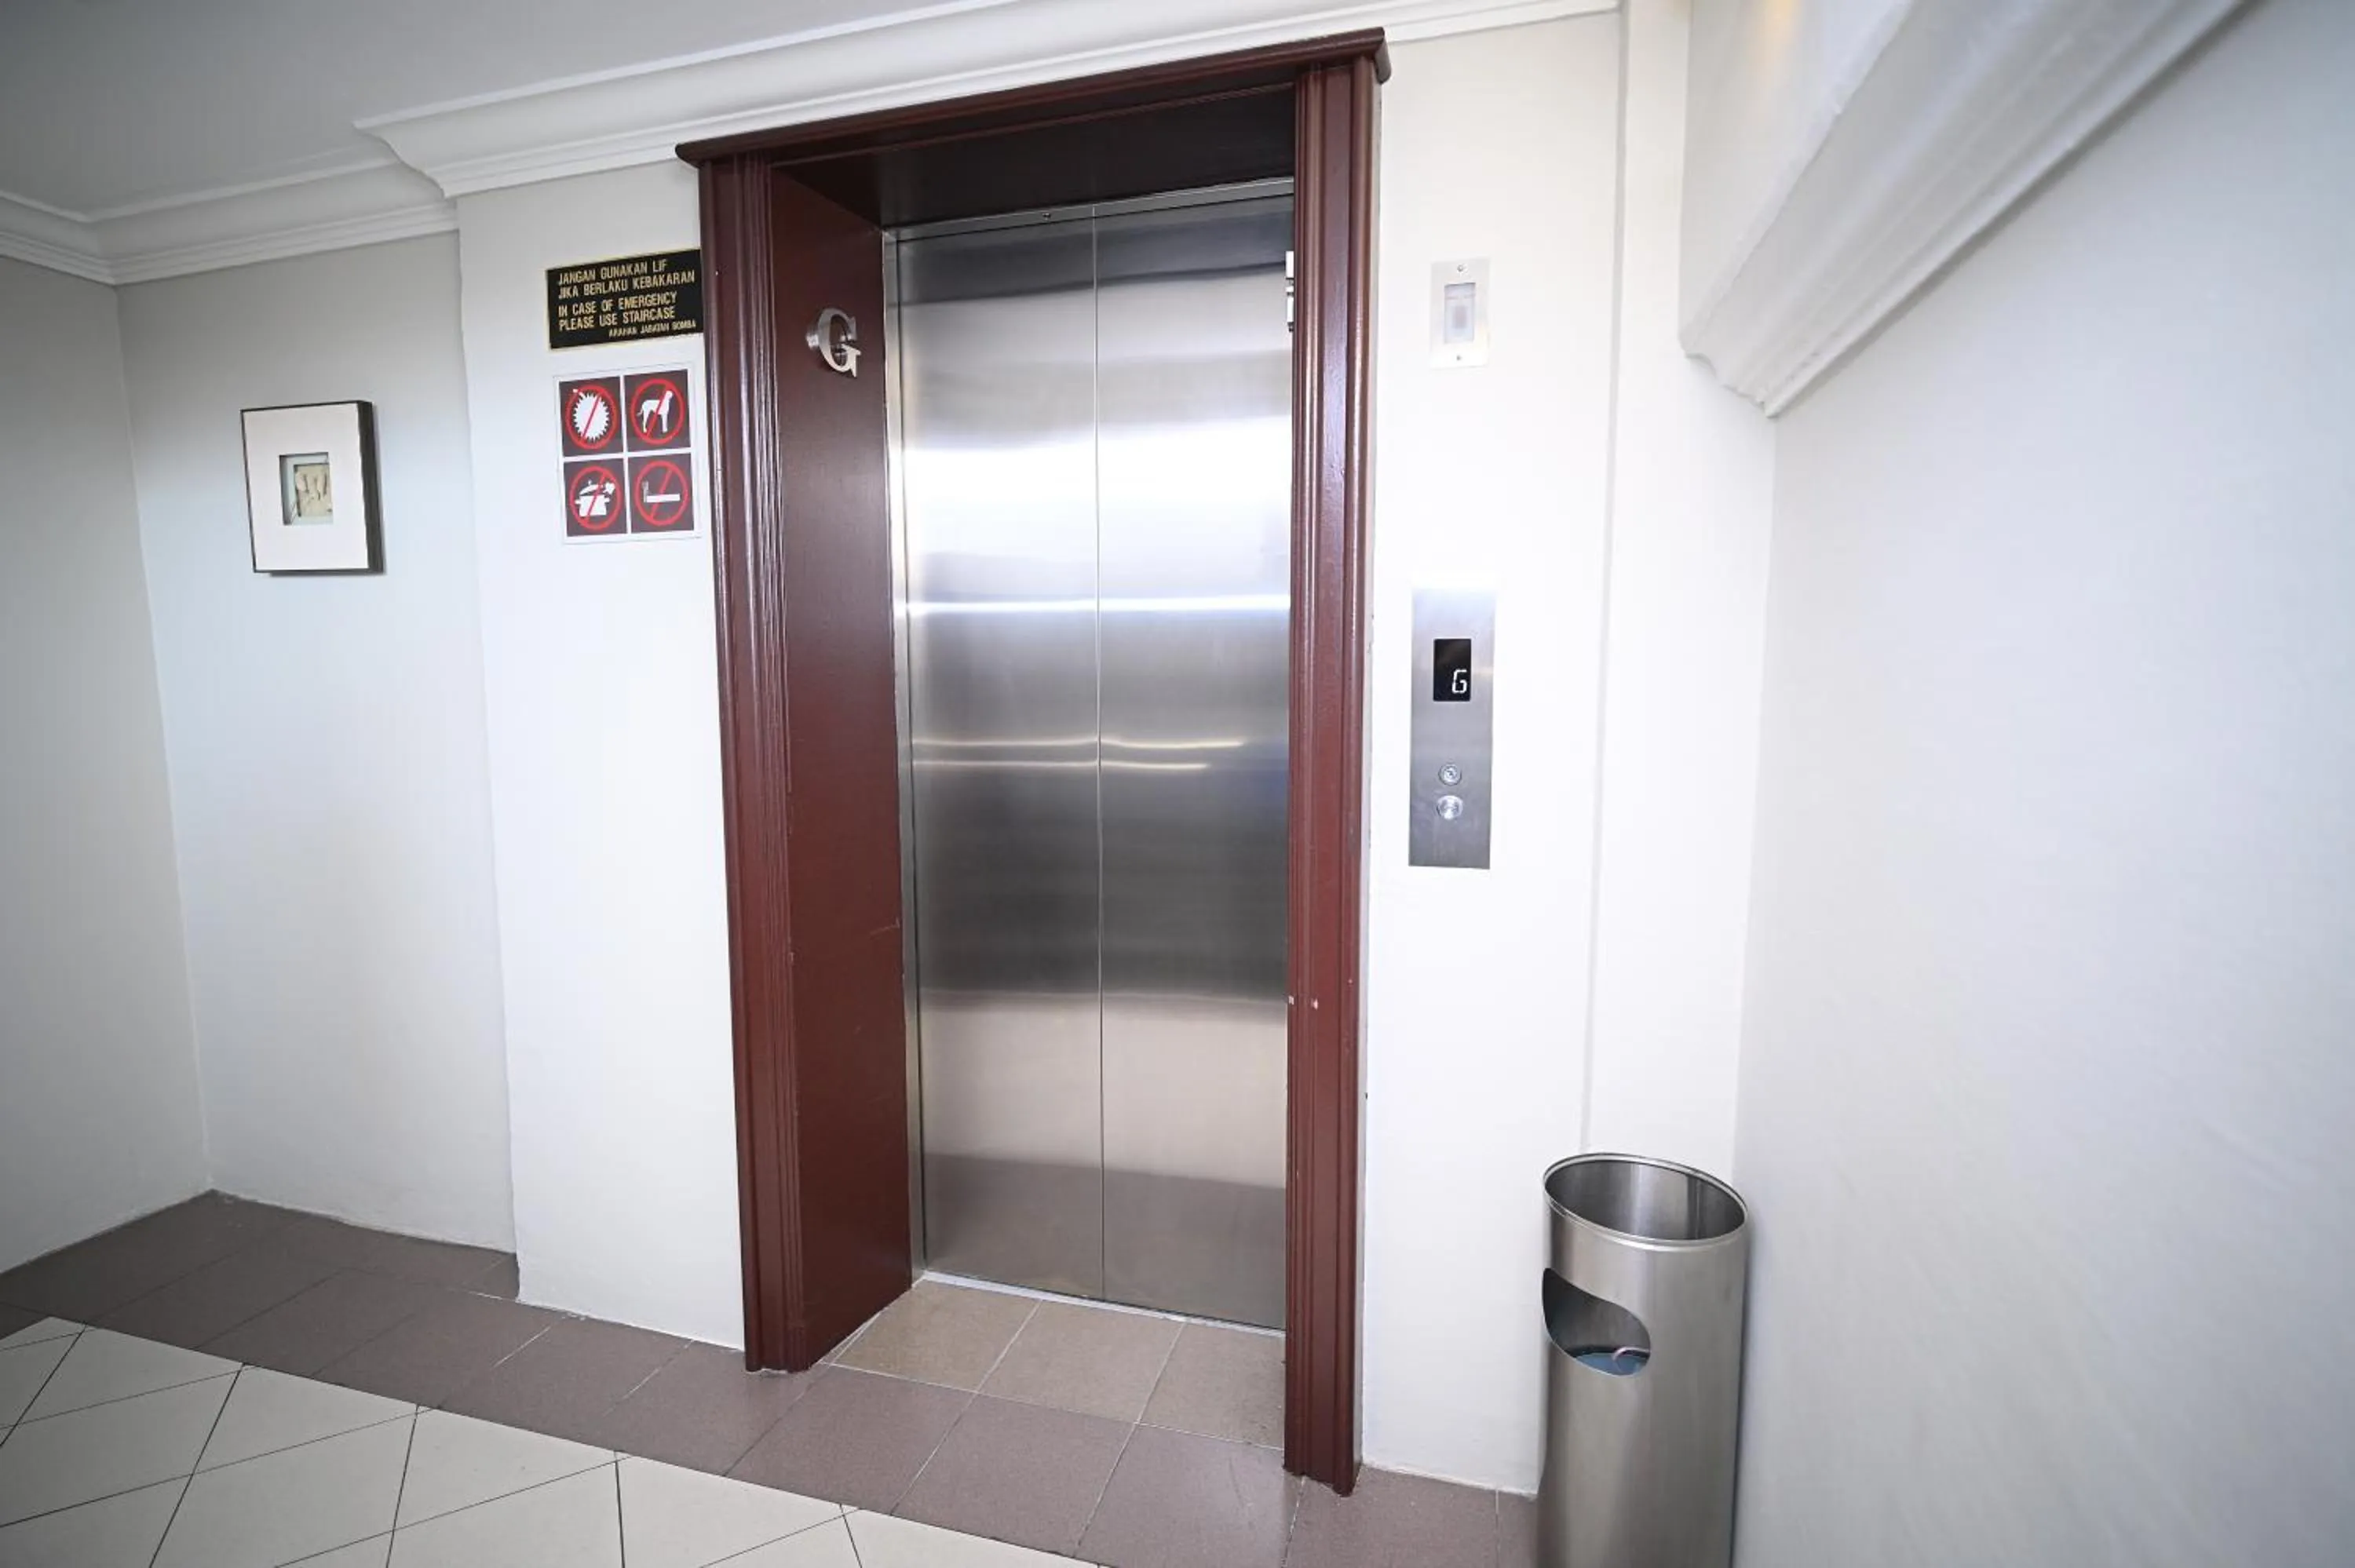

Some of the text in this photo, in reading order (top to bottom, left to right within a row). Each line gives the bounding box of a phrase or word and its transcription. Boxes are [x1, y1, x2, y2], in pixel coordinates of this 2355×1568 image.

[558, 259, 667, 286] JANGAN GUNAKAN LIF
[583, 279, 628, 296] BERLAKU
[633, 270, 696, 290] KEBAKARAN
[558, 291, 678, 317] IN CASE OF EMERGENCY
[559, 306, 676, 331] PLEASE USE STAIRCASE
[816, 307, 862, 377] G
[1451, 669, 1468, 694] G
